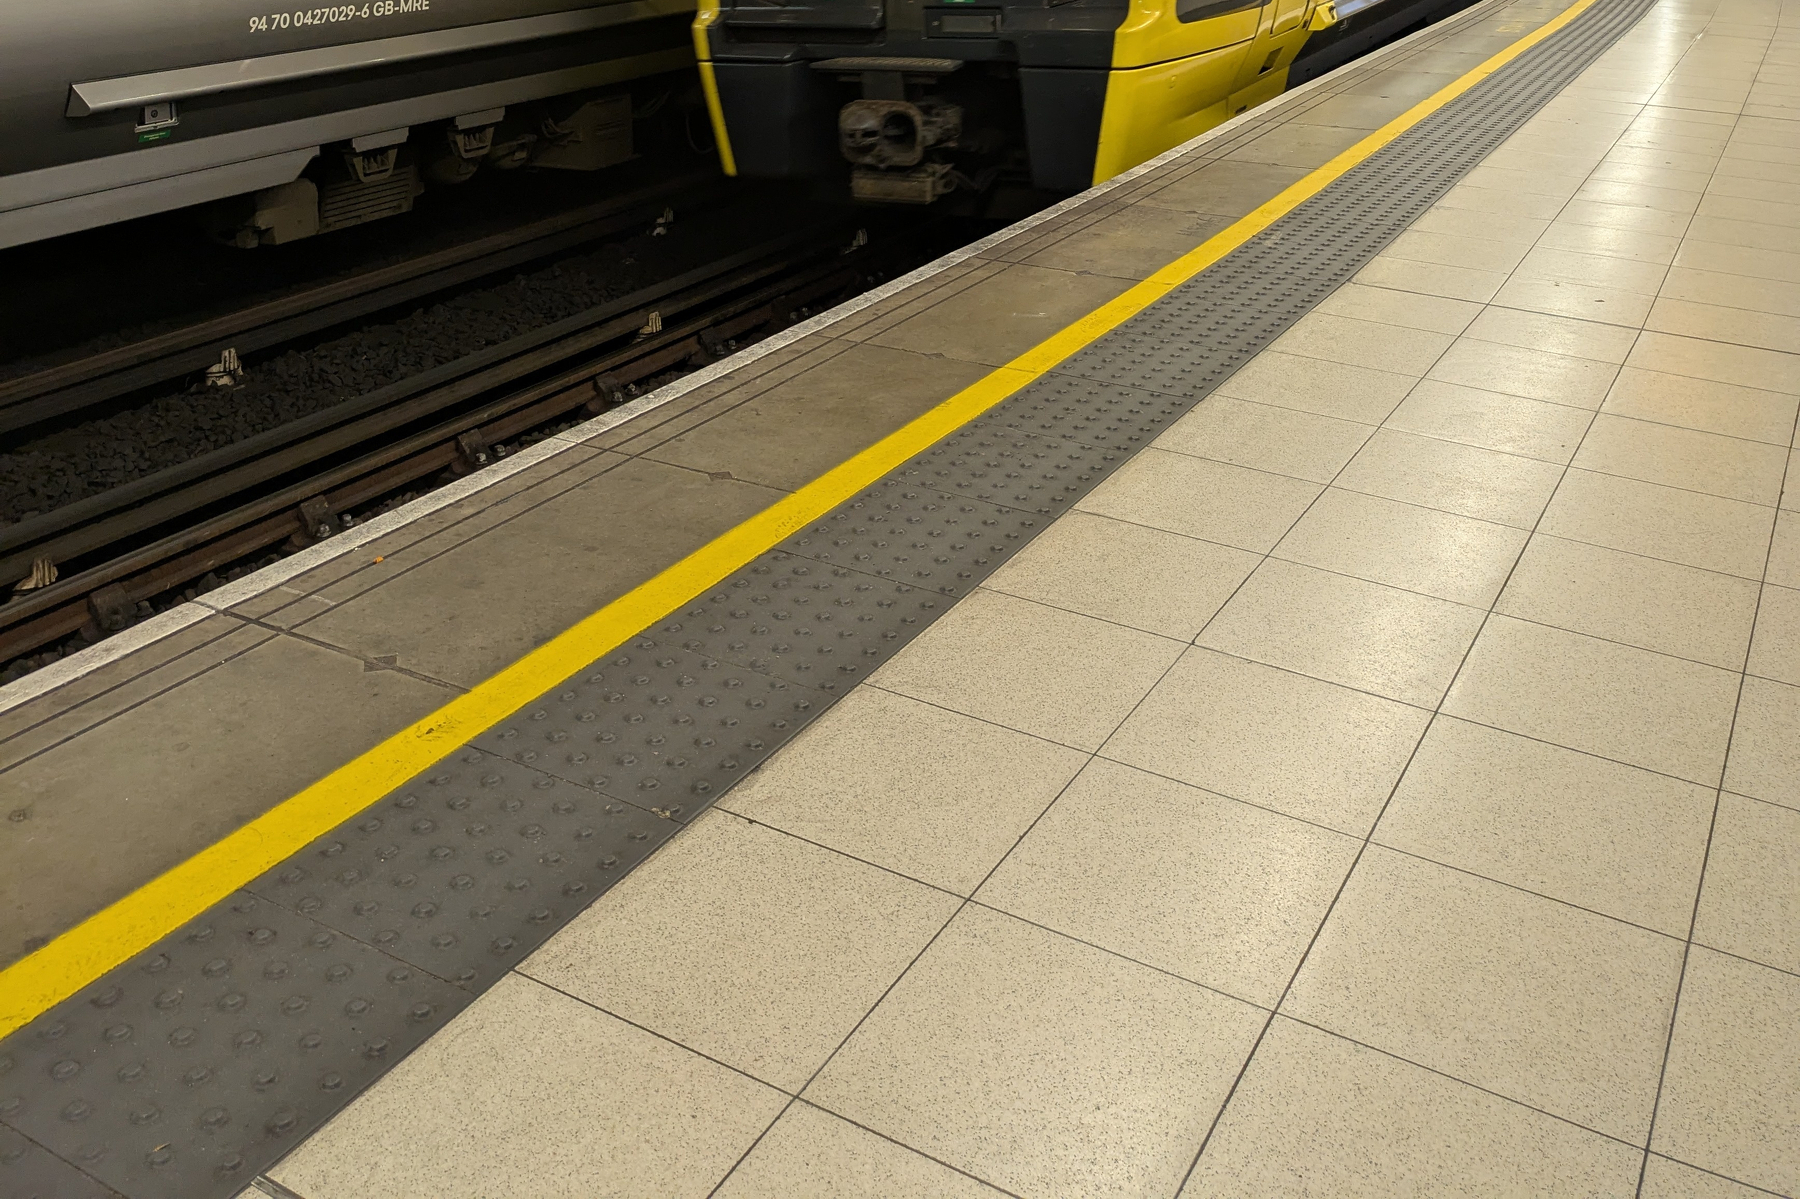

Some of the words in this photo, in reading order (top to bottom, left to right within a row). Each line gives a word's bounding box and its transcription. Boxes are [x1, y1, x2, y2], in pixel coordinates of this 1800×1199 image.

[249, 16, 268, 33] 94
[271, 13, 290, 30] 70
[293, 3, 370, 27] 0427029-6
